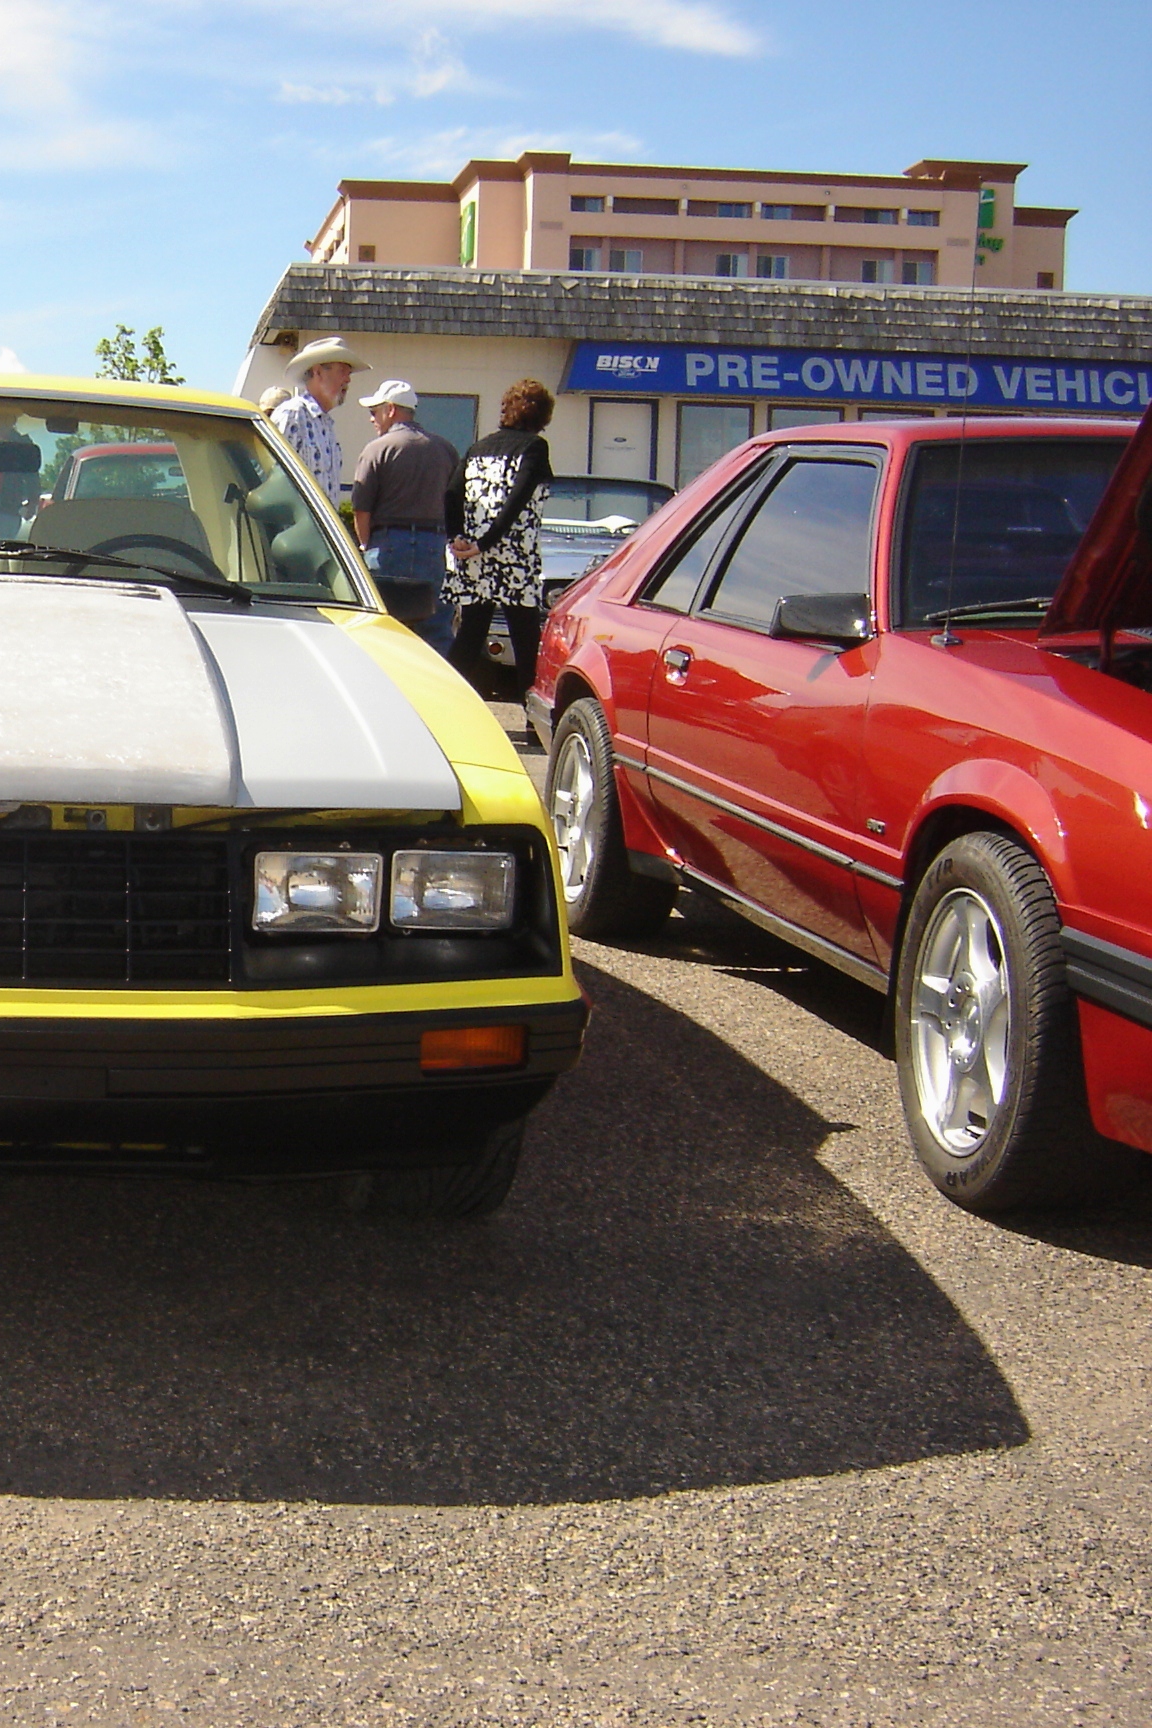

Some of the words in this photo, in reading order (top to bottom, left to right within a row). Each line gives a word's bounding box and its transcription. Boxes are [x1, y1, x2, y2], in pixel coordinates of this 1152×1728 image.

[596, 355, 660, 369] BISON
[685, 353, 979, 397] PRE-OWNED
[992, 365, 1152, 406] VEHICL
